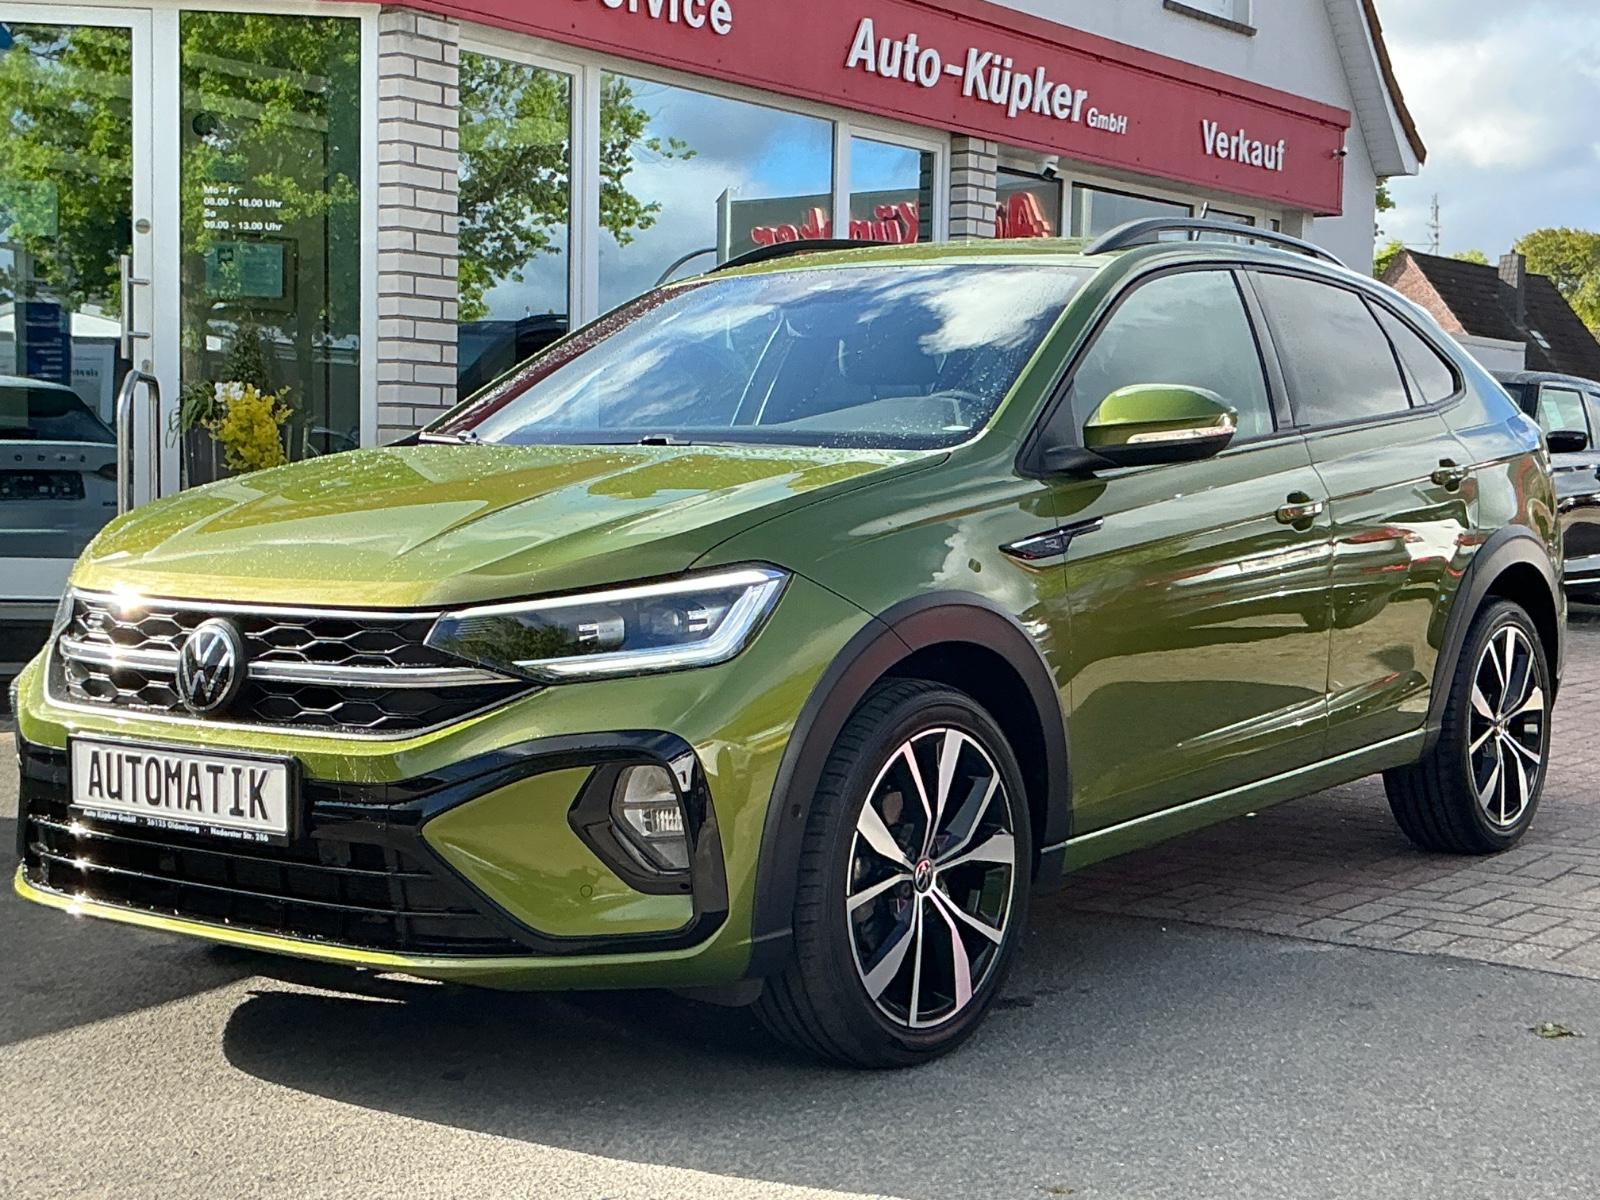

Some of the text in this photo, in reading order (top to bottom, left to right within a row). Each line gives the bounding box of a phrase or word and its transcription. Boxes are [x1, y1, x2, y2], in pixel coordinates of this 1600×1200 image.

[602, 0, 732, 35] vice
[846, 17, 1128, 135] Auto-Küpker GmbH
[1202, 119, 1285, 171] Verkauf
[203, 186, 219, 194] Mo
[228, 186, 238, 195] Fr
[203, 197, 229, 206] 08.00
[238, 198, 263, 208] 18.00
[265, 199, 283, 208] Uhr
[203, 208, 217, 218] Sa
[203, 220, 229, 229] 09.00
[238, 221, 263, 230] 13.00
[265, 222, 283, 231] Uhr
[88, 750, 269, 820] AUTOMATIK
